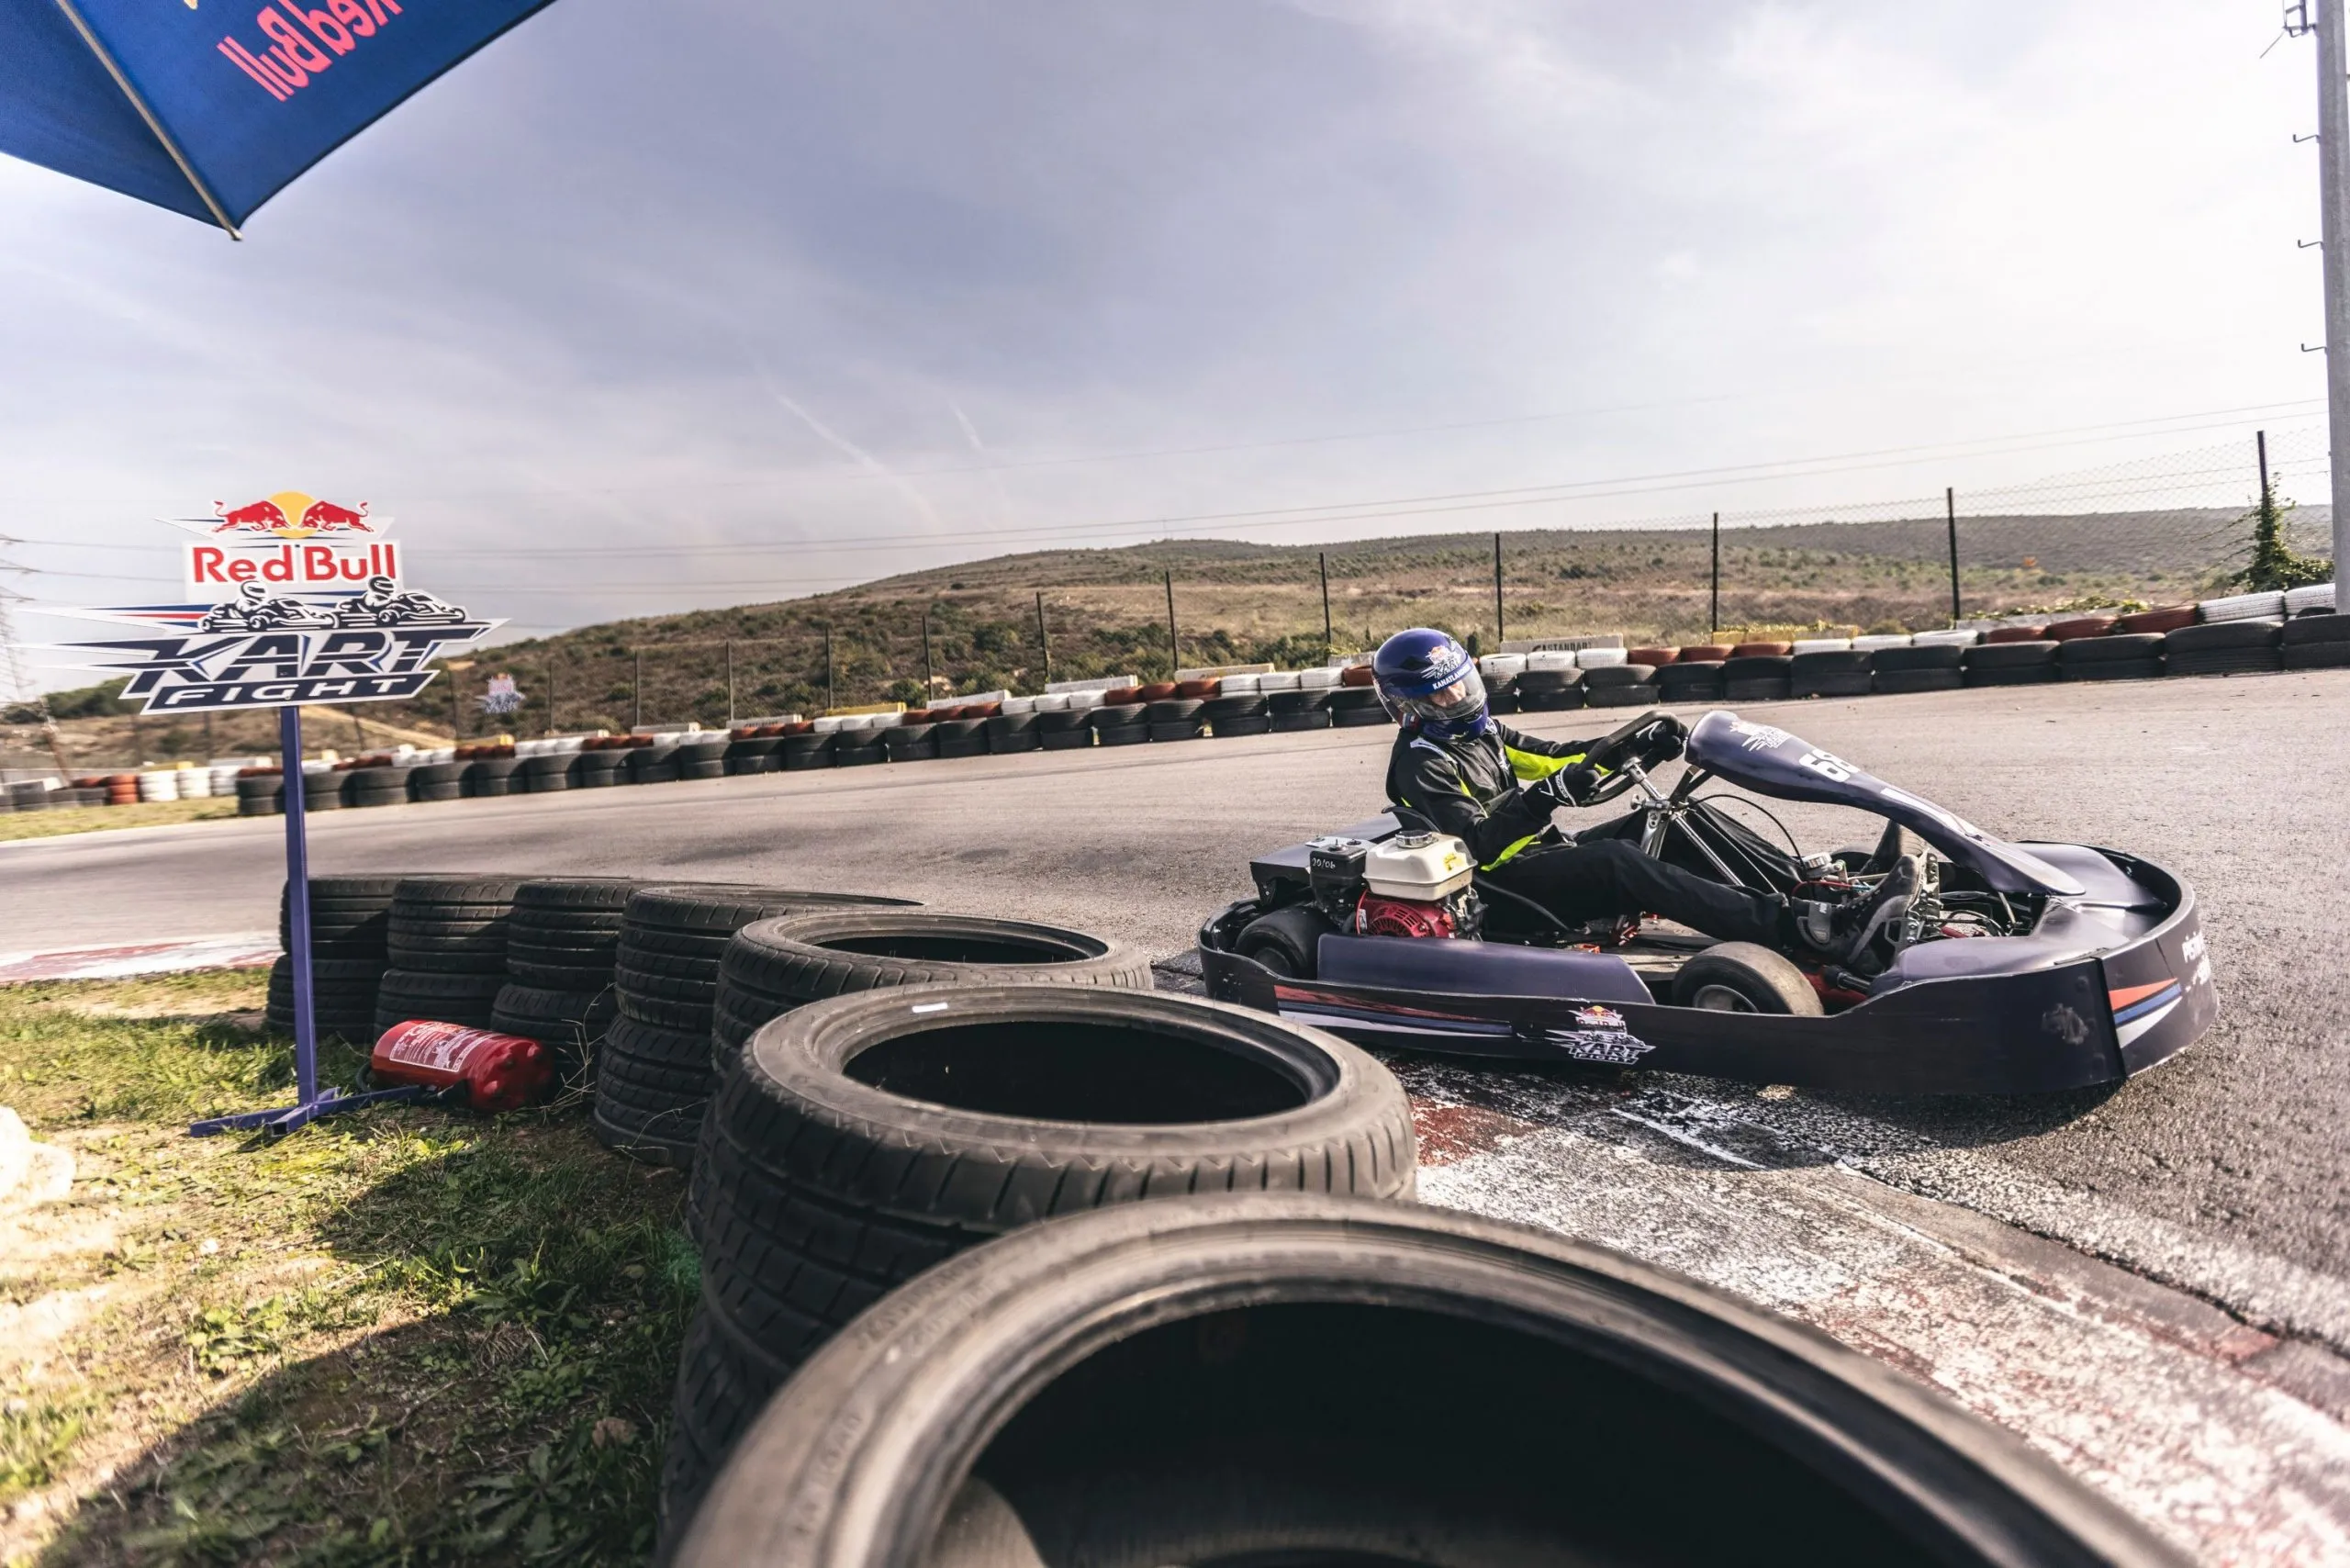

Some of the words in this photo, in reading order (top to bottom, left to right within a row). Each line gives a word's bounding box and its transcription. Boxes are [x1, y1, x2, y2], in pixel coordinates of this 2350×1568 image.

[192, 544, 294, 583] Red
[303, 543, 397, 581] Bull
[87, 626, 489, 694] KART
[163, 677, 408, 705] FIGHT
[1798, 748, 1861, 782] 68
[1565, 1041, 1653, 1058] KART
